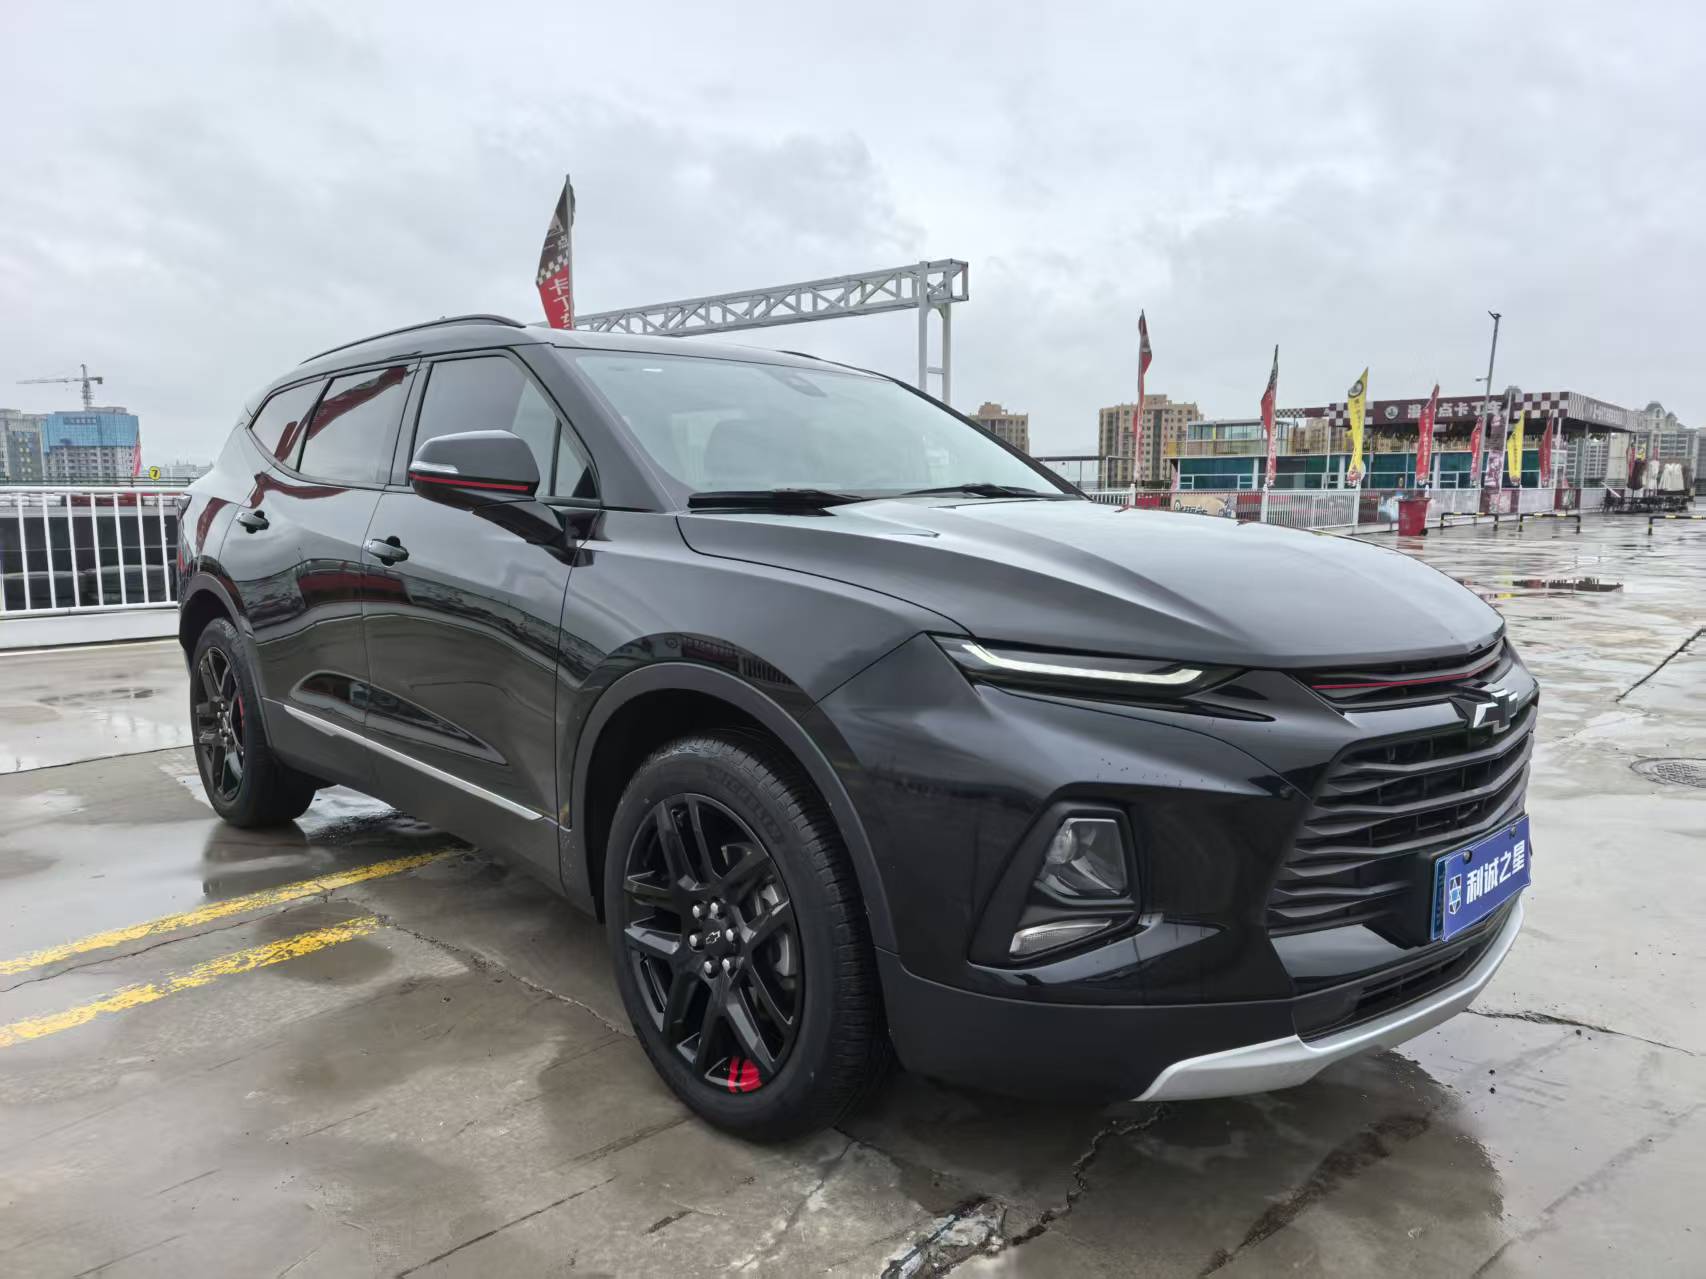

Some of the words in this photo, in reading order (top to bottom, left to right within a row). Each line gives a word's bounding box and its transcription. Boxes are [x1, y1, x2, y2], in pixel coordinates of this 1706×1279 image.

[1408, 400, 1503, 418] 点卡丁车
[1467, 840, 1525, 904] 利诚之星
